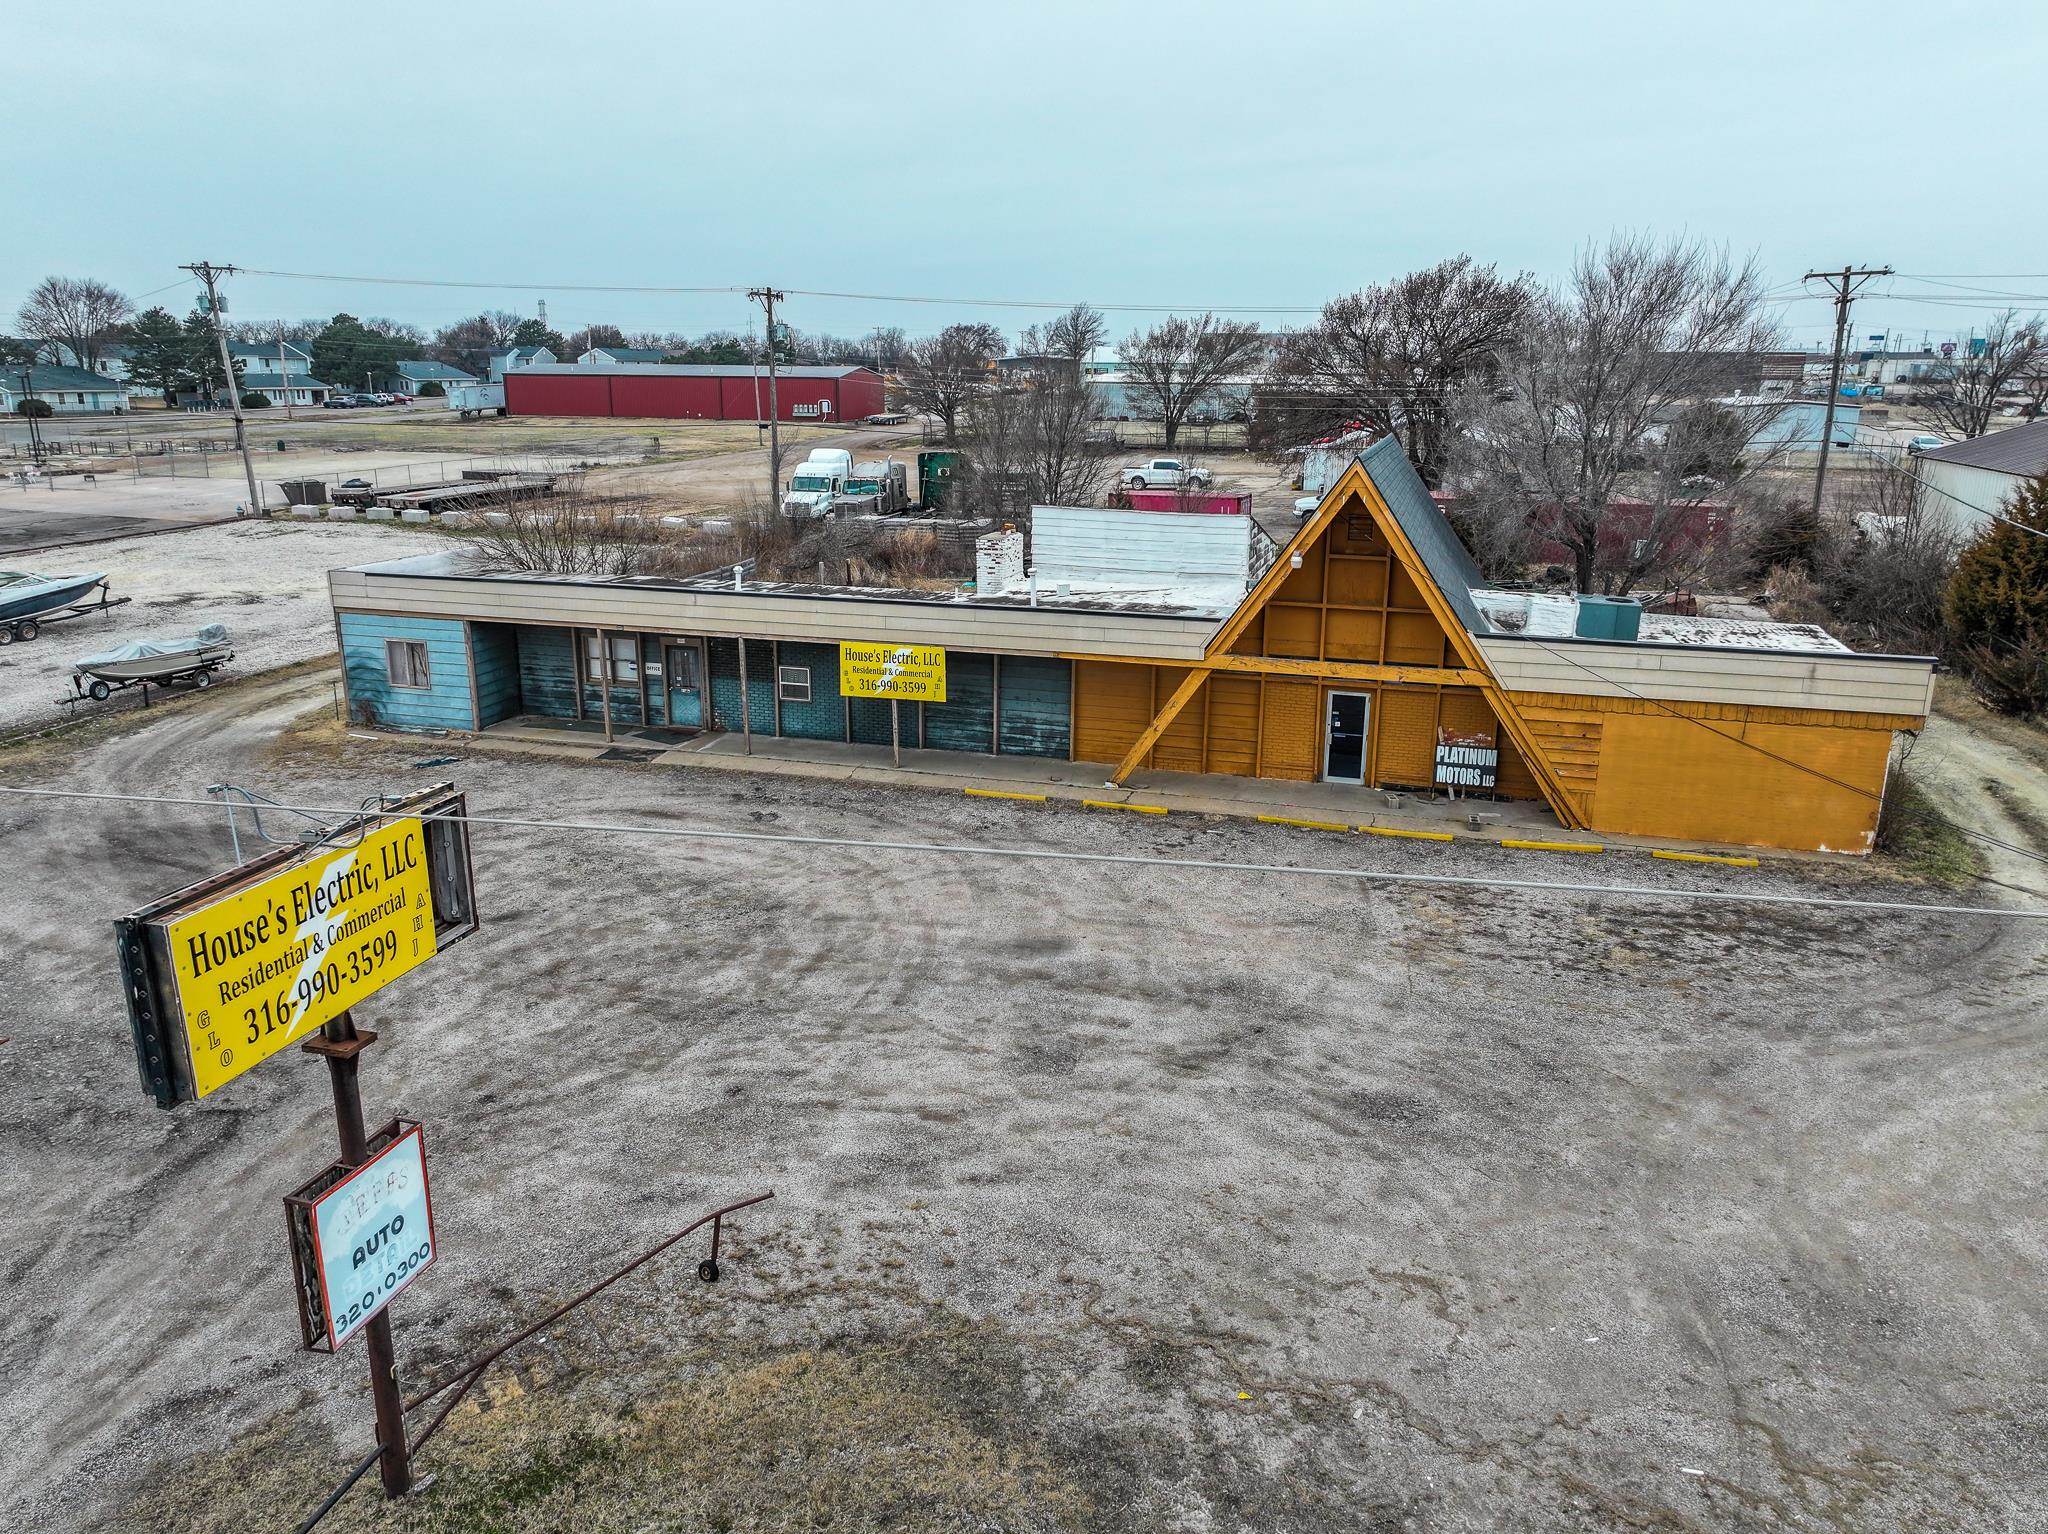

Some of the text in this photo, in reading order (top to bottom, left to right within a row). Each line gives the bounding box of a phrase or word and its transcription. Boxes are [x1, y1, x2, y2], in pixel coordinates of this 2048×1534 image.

[845, 647, 941, 668] House's Electric, LLC
[852, 665, 933, 679] Residential & Commercial
[859, 678, 927, 694] 316-990-3599
[1436, 745, 1498, 767] PLATINUM
[1436, 765, 1495, 787] MOTORS LLC
[187, 832, 418, 979] House's Electric, LLC
[218, 887, 407, 1006] Residential & Commercial
[243, 929, 398, 1044] 316-990-3599
[352, 1214, 405, 1271] AUTO
